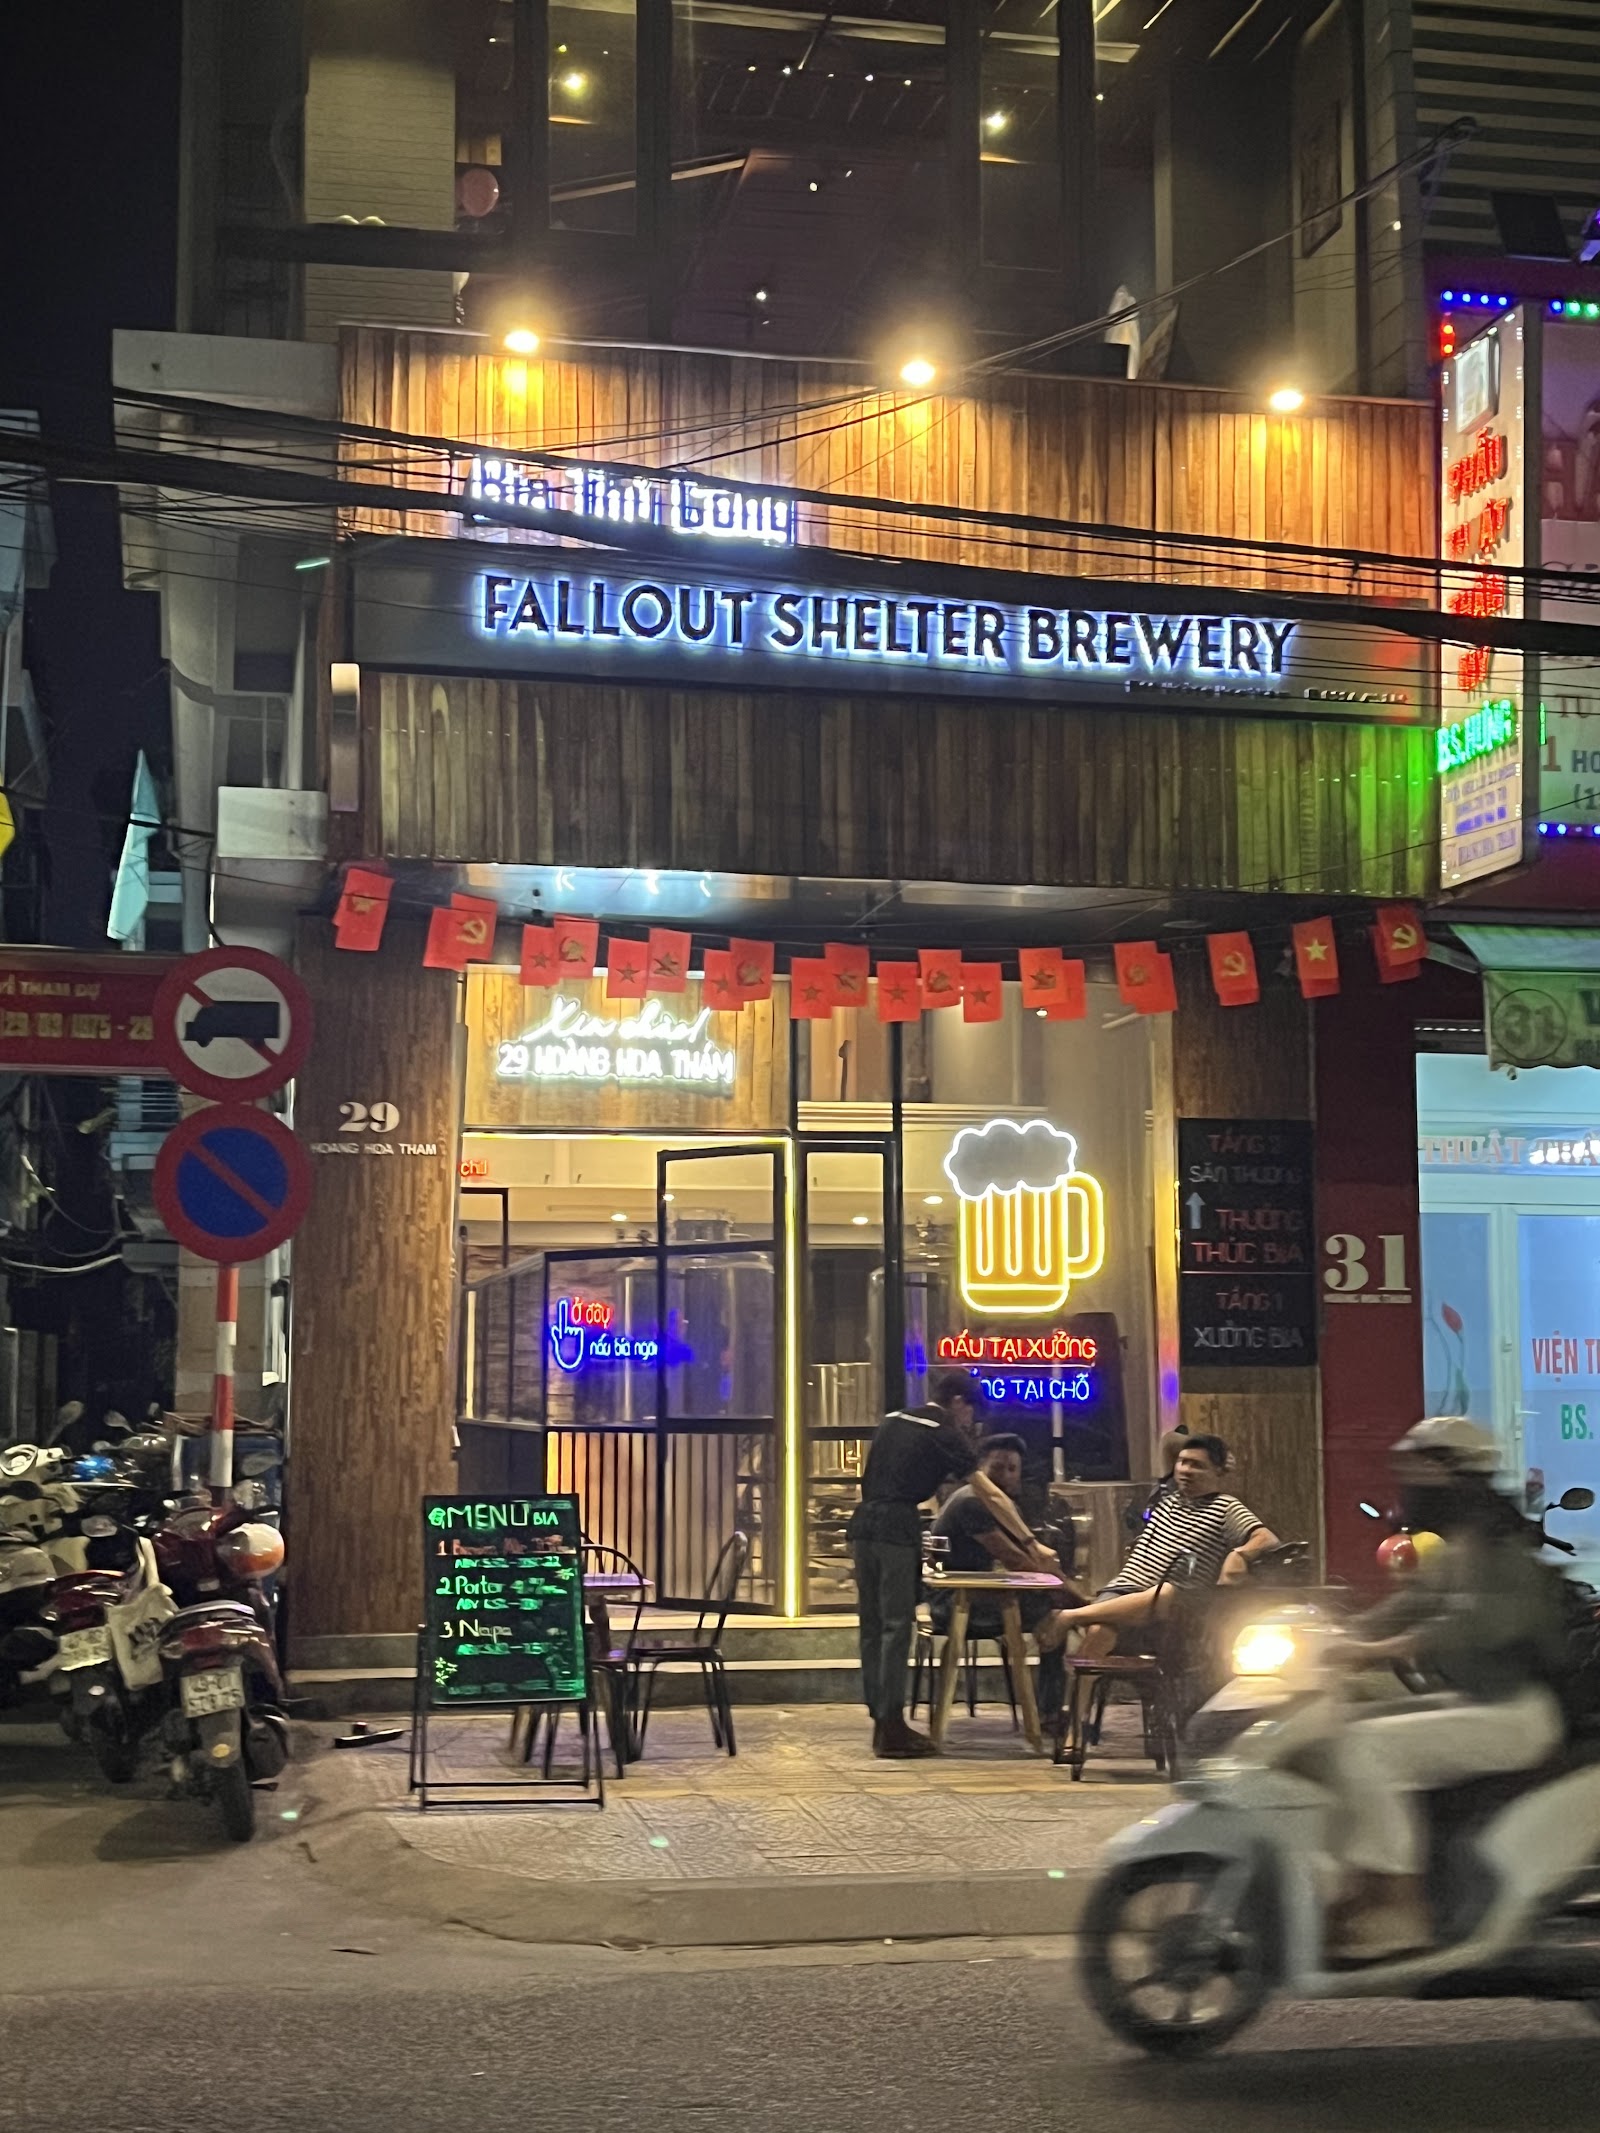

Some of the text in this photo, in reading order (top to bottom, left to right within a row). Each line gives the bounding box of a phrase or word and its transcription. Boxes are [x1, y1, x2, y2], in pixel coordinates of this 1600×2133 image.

[482, 574, 1299, 677] FALLOUT SHELTER BREWERY
[1543, 736, 1562, 772] 1
[499, 1043, 529, 1075] 29
[534, 1037, 611, 1077] HOÀNG
[615, 1047, 665, 1079] HOA
[338, 1101, 400, 1133] 29
[1324, 1233, 1412, 1292] 31
[986, 1338, 1023, 1363] TẠI
[1271, 1327, 1304, 1348] BIA
[1531, 1329, 1579, 1383] VIỆN
[1049, 1372, 1090, 1401] CHỖ
[1561, 1403, 1594, 1440] BS.
[447, 1503, 559, 1530] MENU BIA
[435, 1576, 453, 1595] 2
[439, 1621, 453, 1638] 3
